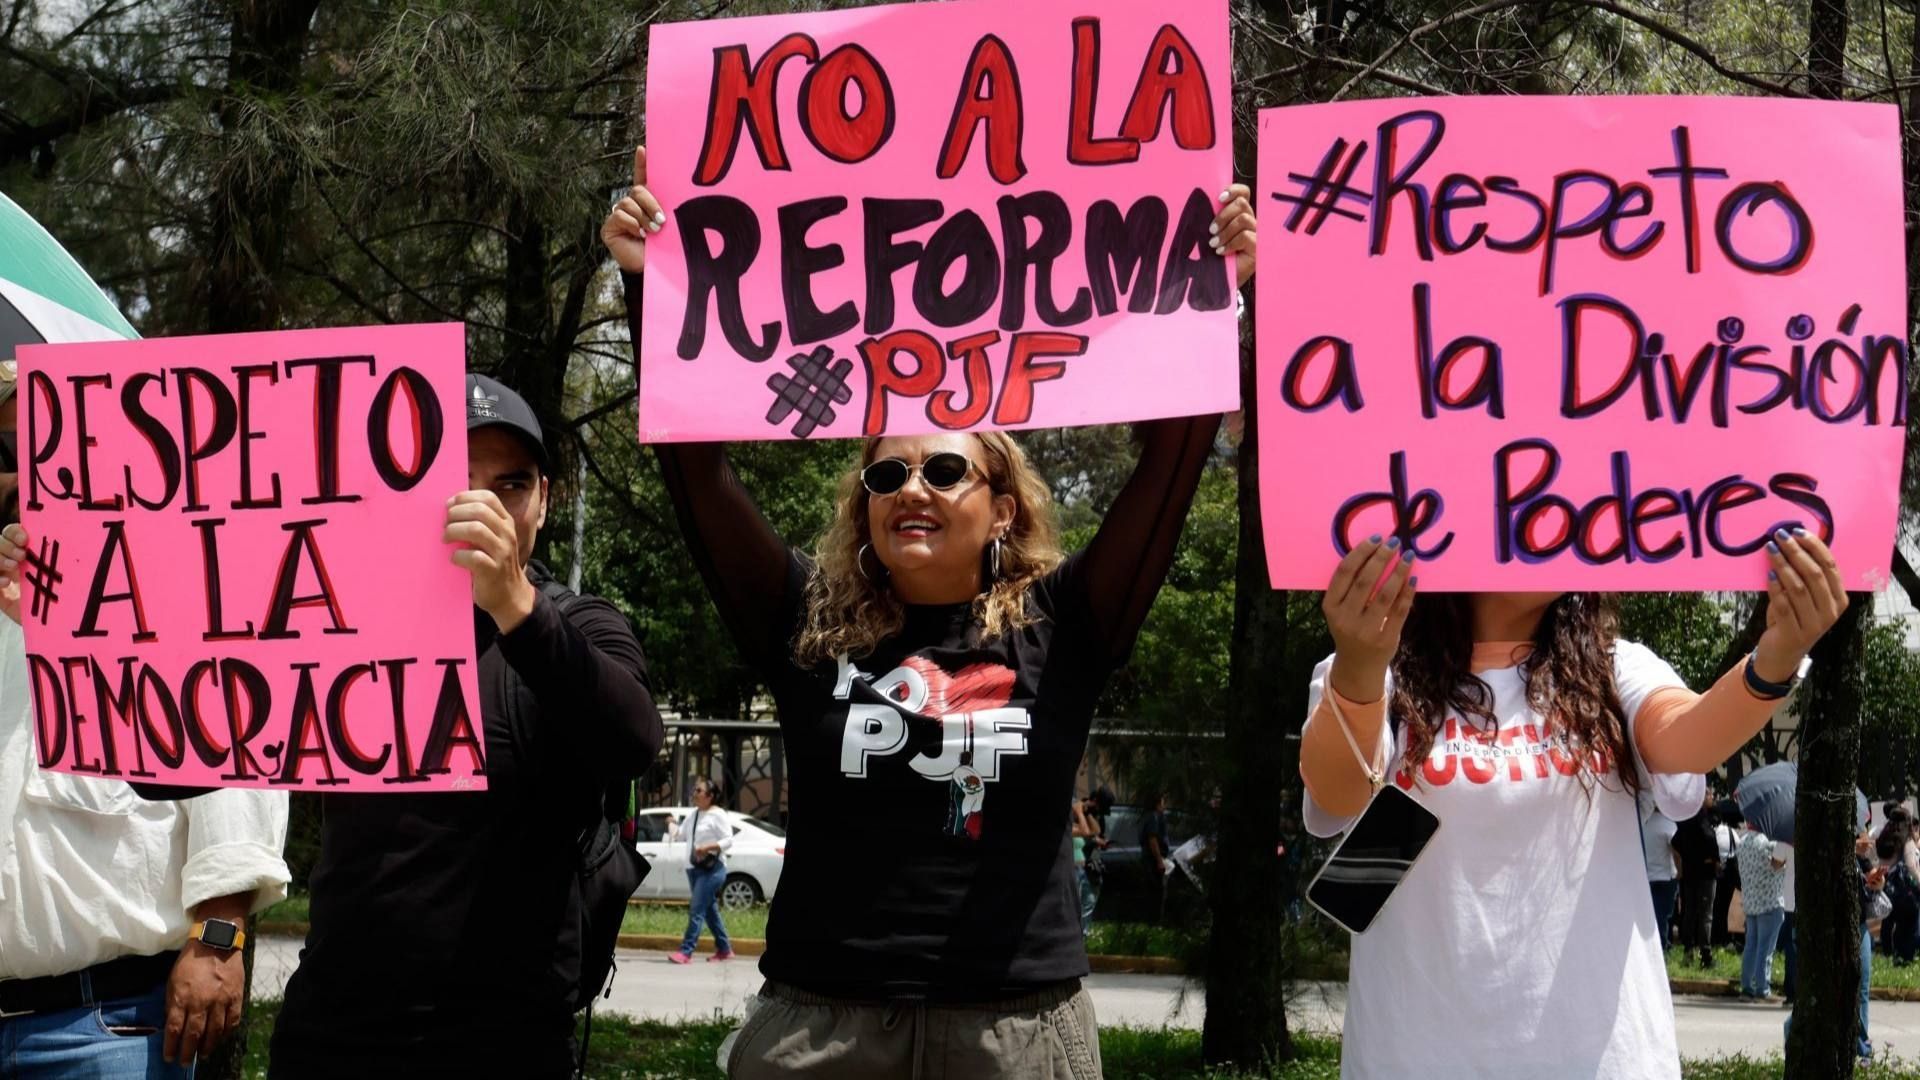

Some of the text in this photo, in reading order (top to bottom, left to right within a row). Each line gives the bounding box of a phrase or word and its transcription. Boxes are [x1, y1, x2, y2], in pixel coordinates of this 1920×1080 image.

[692, 16, 1217, 187] NO A LA
[1271, 110, 1815, 297] #Respeto
[673, 187, 1232, 362] REFORMA
[766, 328, 1089, 438] #PJF
[1280, 282, 1907, 428] a la División
[26, 355, 444, 513] RESPETO
[1331, 438, 1834, 565] de Poderes
[191, 517, 358, 641] LA
[26, 653, 488, 786] DEMOCRACIA
[840, 703, 1033, 782] PJF
